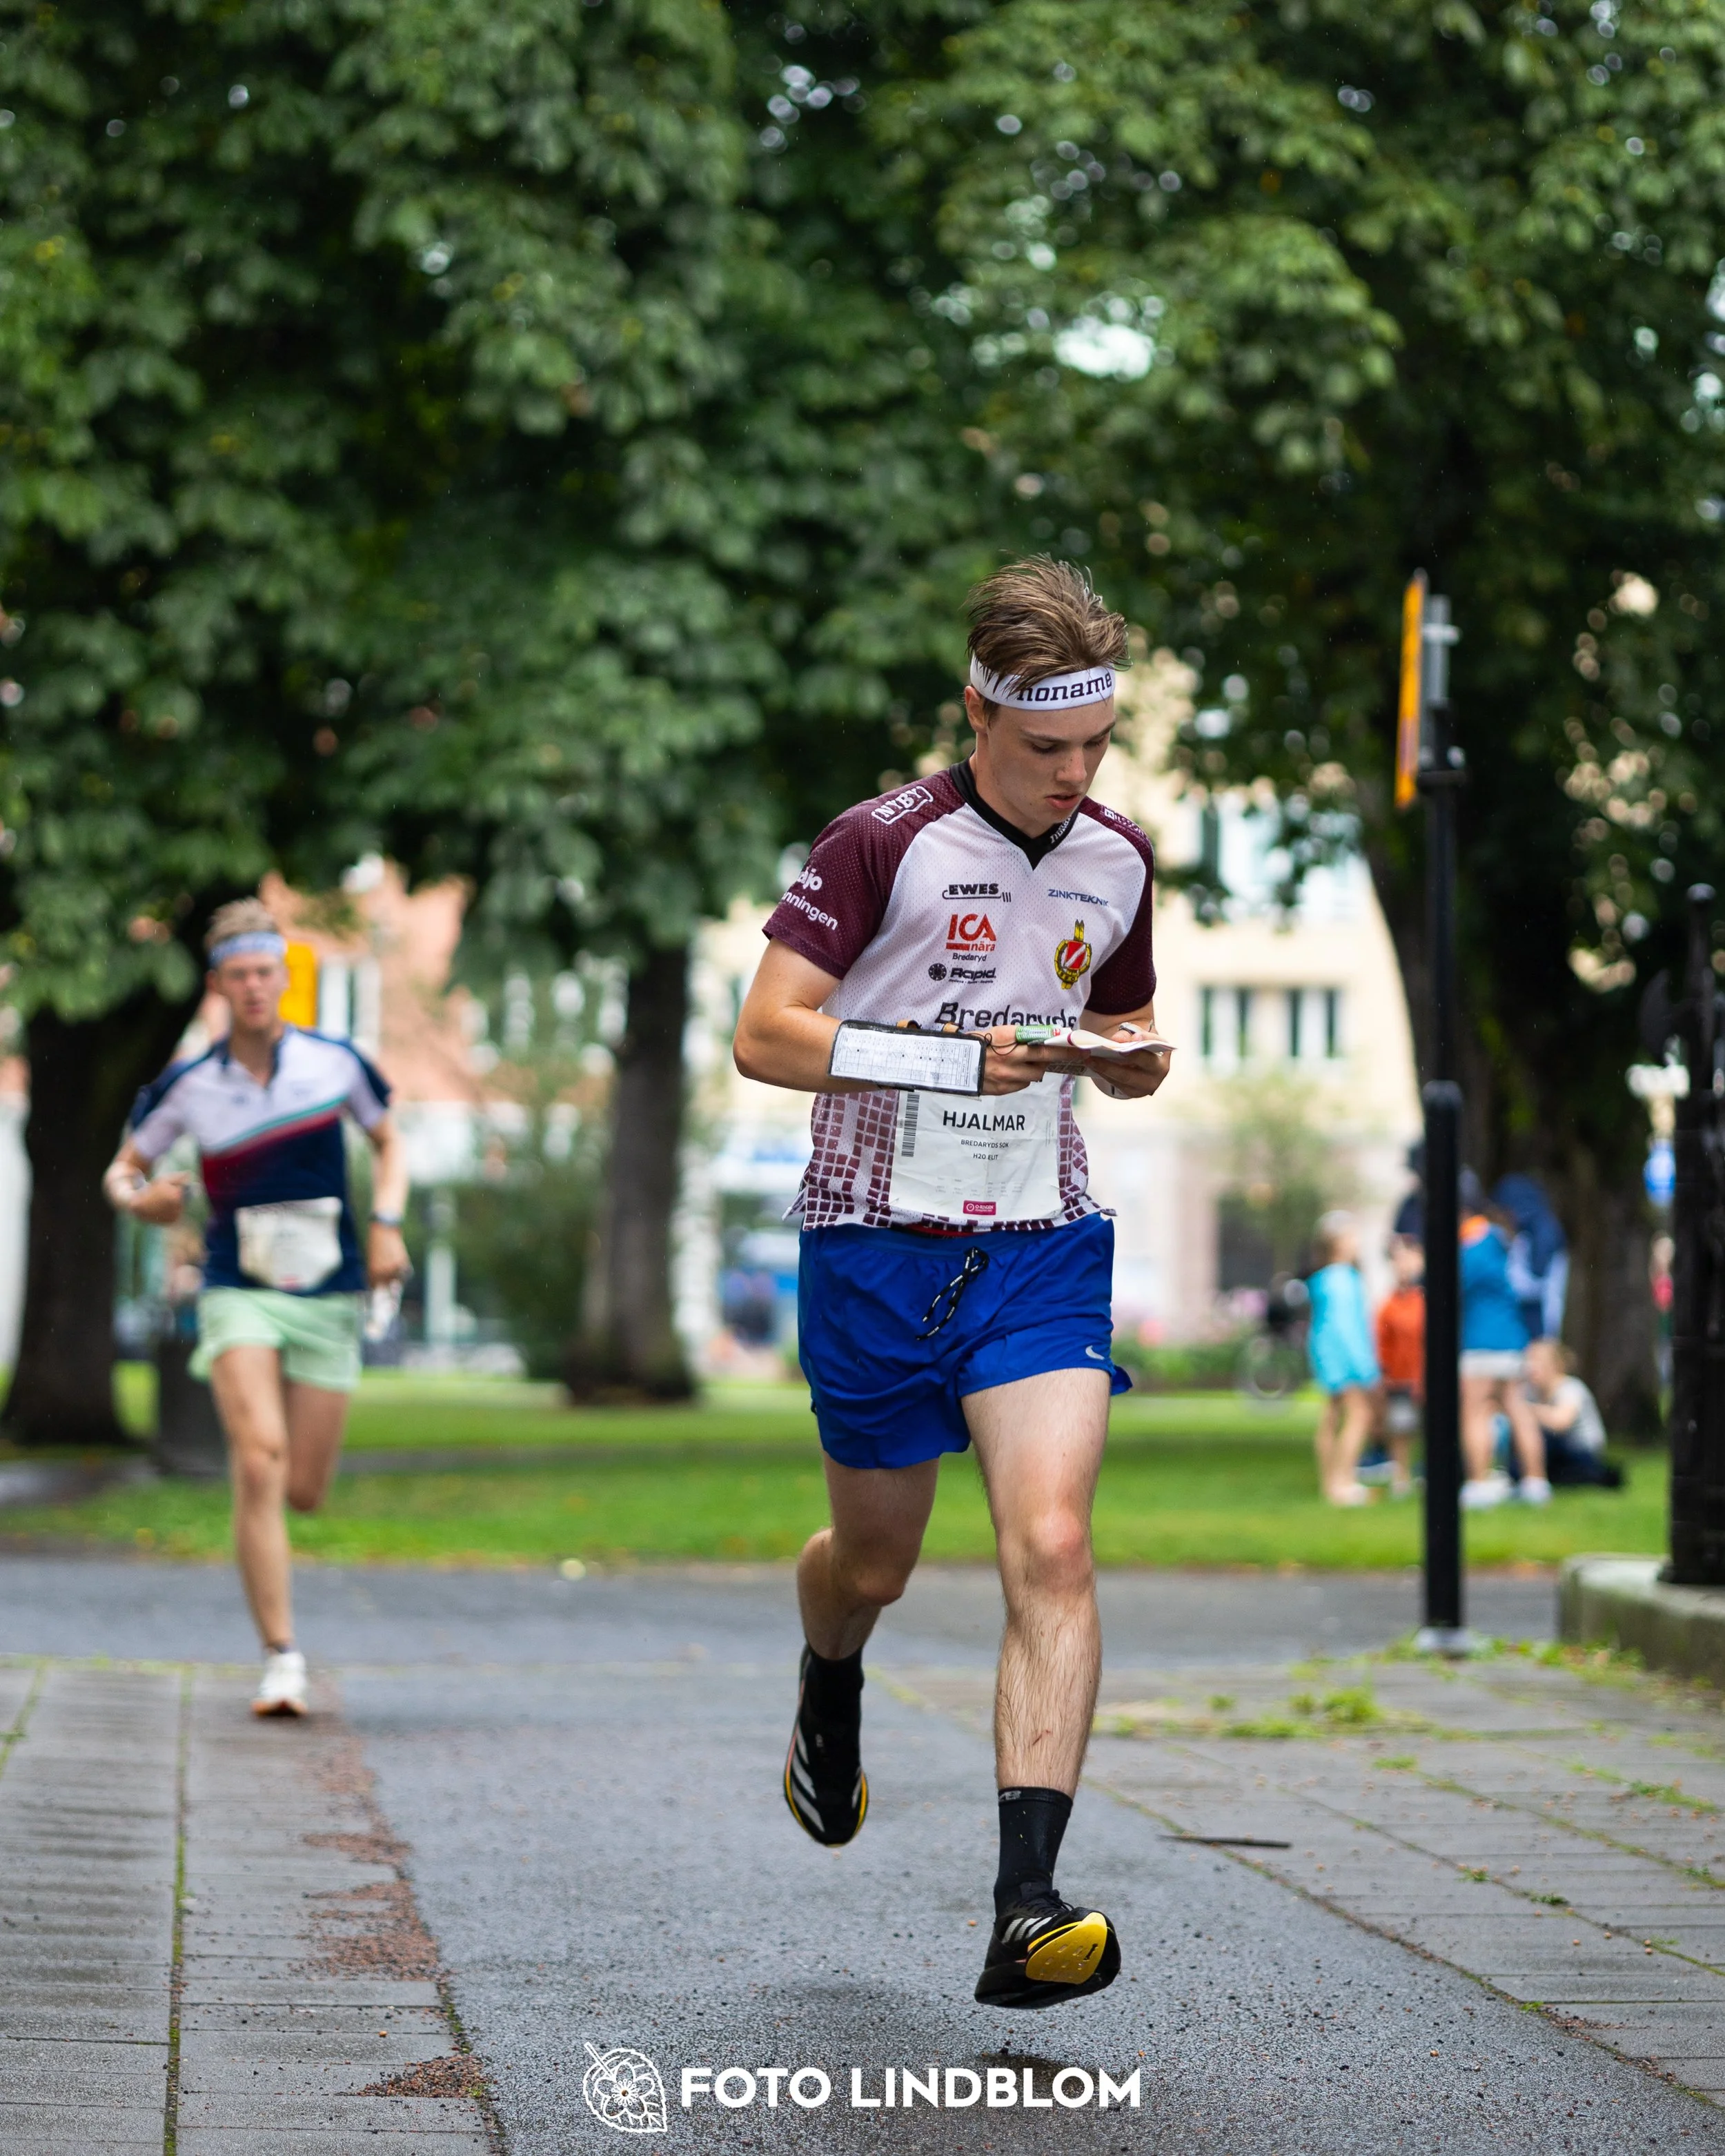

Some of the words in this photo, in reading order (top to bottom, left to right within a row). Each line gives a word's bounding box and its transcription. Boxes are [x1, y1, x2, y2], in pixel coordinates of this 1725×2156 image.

[1017, 671, 1112, 702] noname
[874, 788, 923, 818] NYBY
[948, 883, 999, 896] EWES
[947, 913, 996, 942] ICA
[971, 941, 996, 951] nära
[952, 953, 987, 962] Bredaryd
[950, 967, 996, 981] Rapid
[943, 1110, 1025, 1131] HJALMAR
[960, 1139, 998, 1148] BREDARYDS
